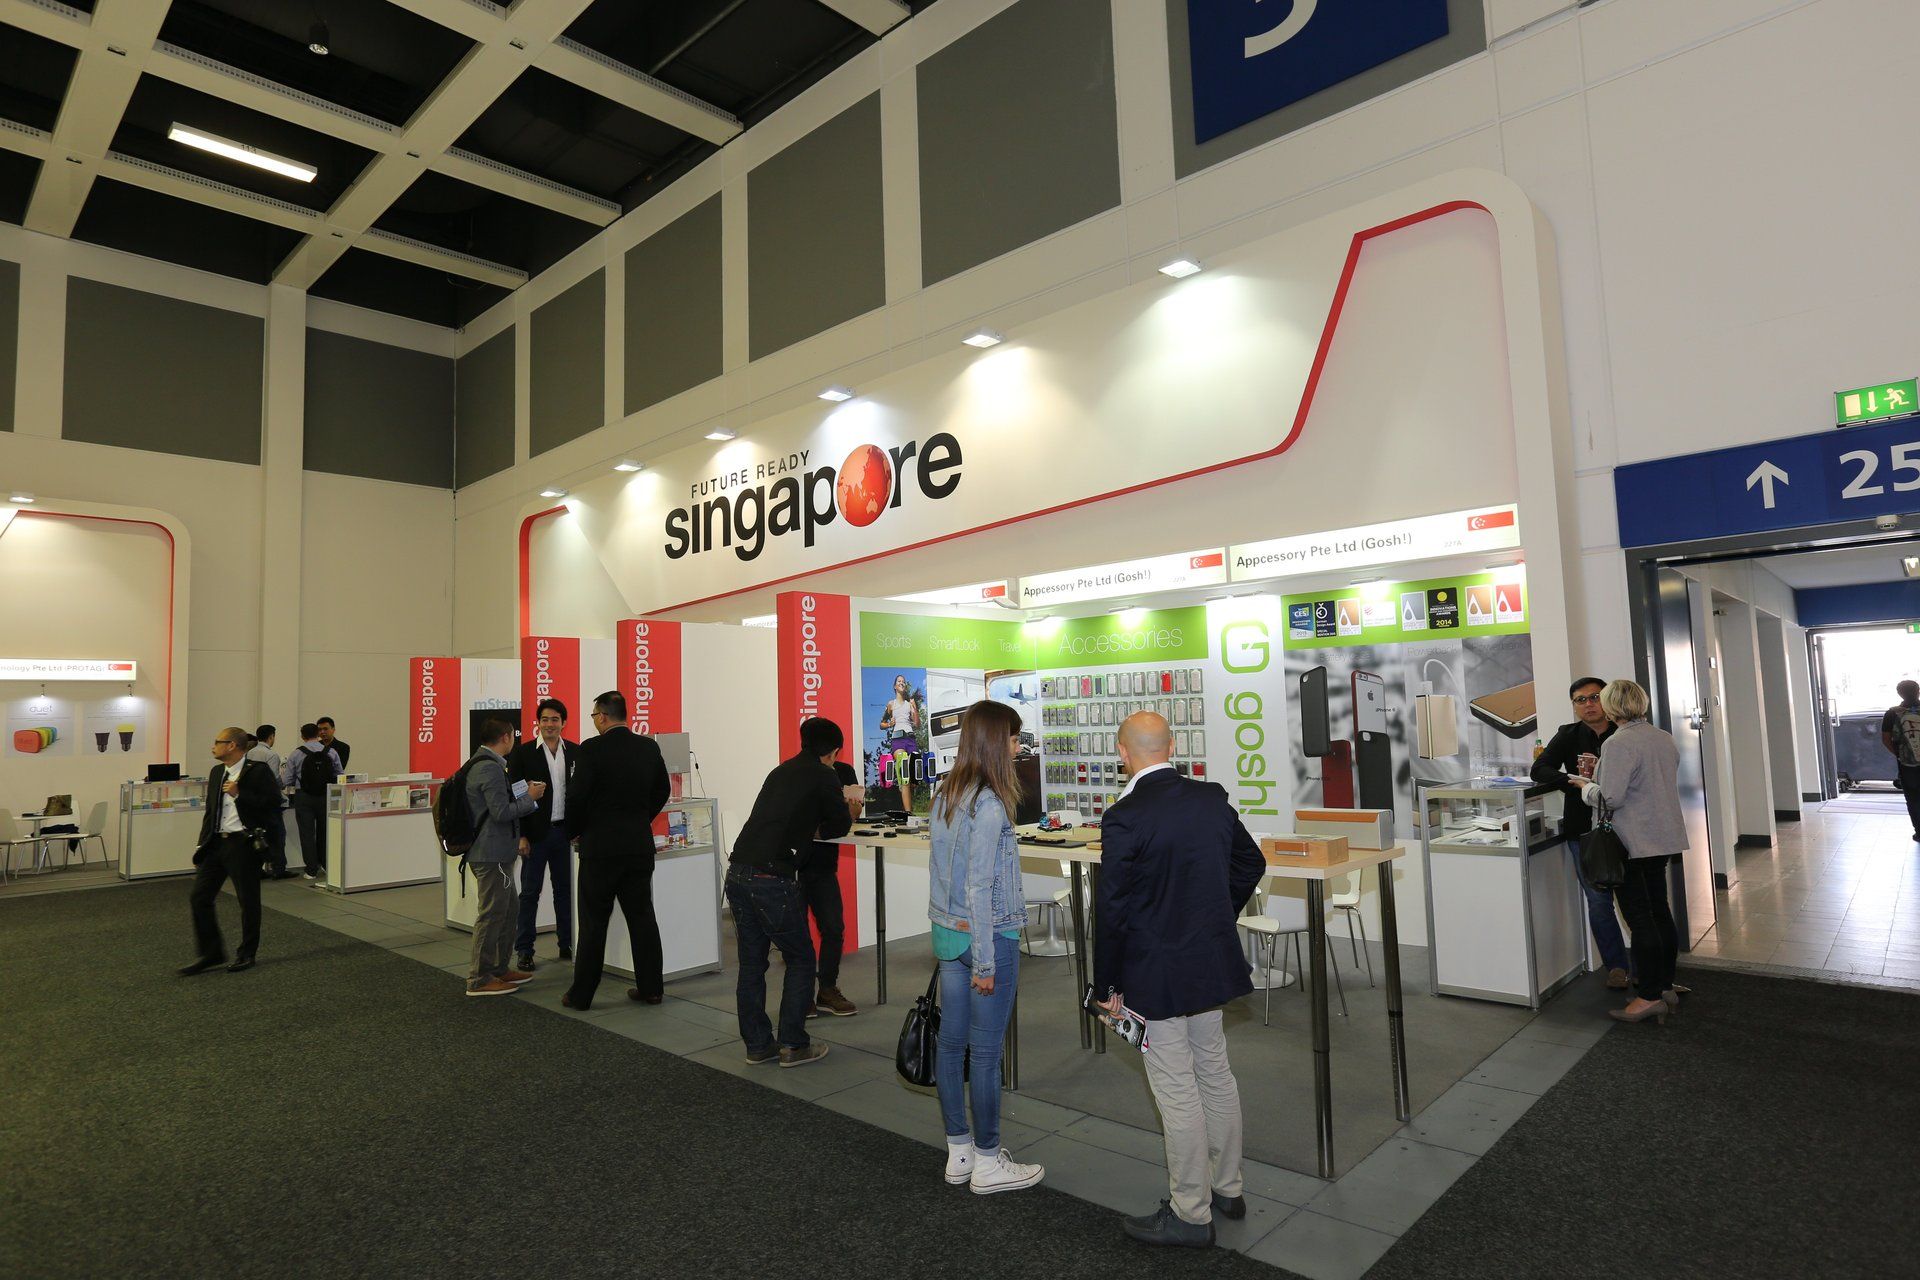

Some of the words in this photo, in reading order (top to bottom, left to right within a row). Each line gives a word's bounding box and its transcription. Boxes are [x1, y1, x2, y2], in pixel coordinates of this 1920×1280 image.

[691, 467, 749, 499] FUTURE
[756, 449, 811, 478] READY
[1839, 441, 1920, 499] 25
[1236, 547, 1307, 567] Appcessory
[1310, 544, 1332, 557] Pte
[1335, 539, 1357, 554] Ltd
[1361, 532, 1413, 551] (Gosh!)
[1023, 580, 1075, 597] Appcessory
[1077, 577, 1094, 589] Pte
[1096, 575, 1112, 586] Ltd
[1114, 569, 1151, 584] (Gosh!)
[876, 633, 912, 650] Sports
[997, 638, 1021, 653] Trave
[1058, 625, 1183, 656] Accessories
[32, 664, 47, 672] Pte
[48, 664, 63, 672] Ltd
[631, 622, 654, 736] Singapore
[418, 659, 437, 743] Singapore
[1224, 691, 1279, 816] gosh!
